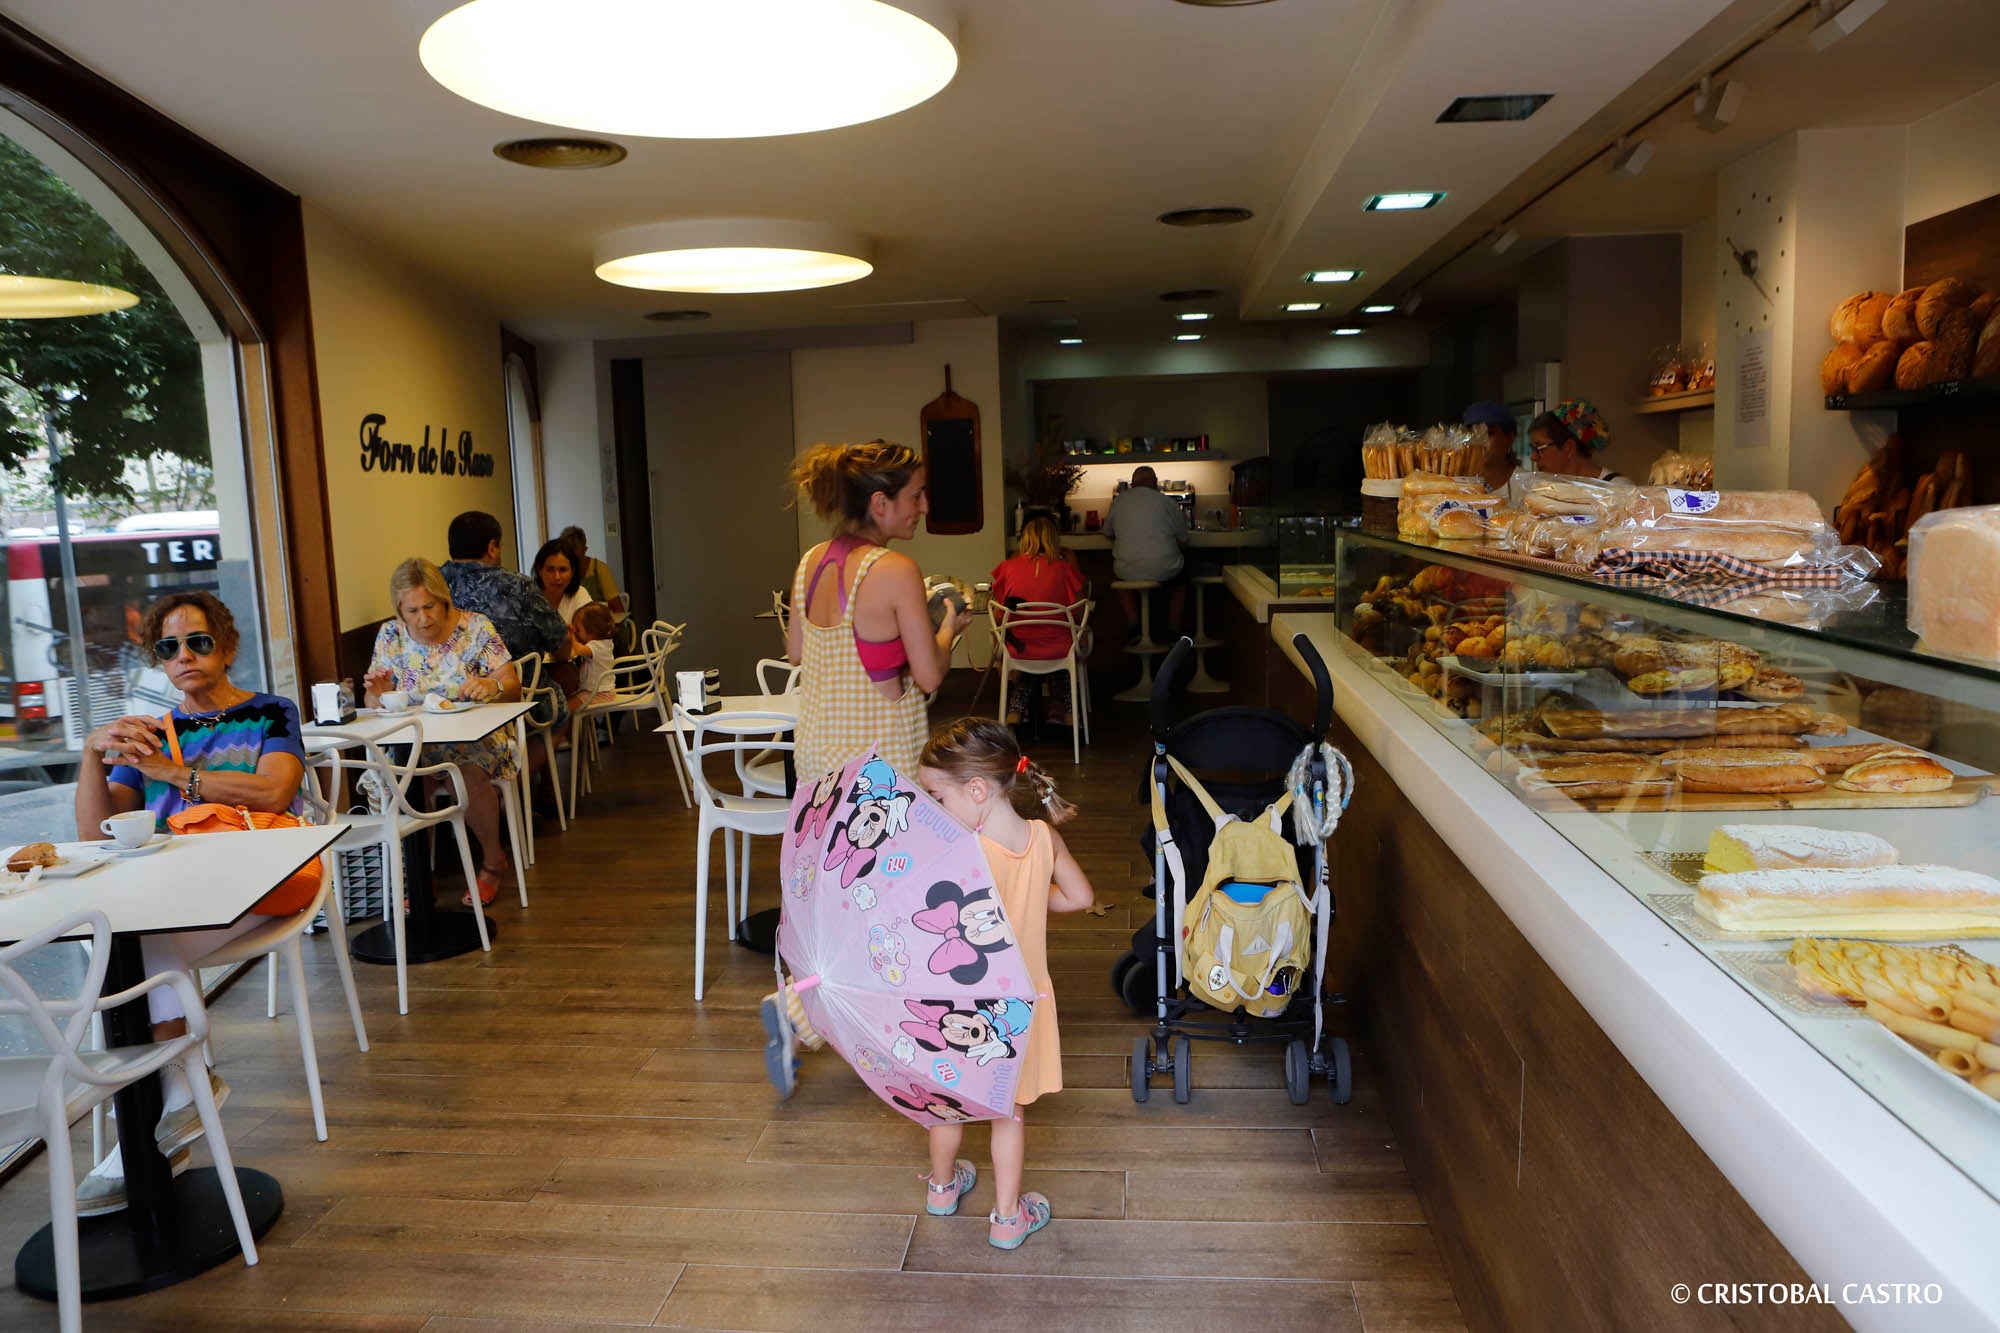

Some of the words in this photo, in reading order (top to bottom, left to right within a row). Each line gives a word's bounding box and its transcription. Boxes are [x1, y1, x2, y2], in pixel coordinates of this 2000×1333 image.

[360, 413, 416, 473] Forn
[418, 425, 438, 475] de
[440, 427, 456, 476] la
[141, 539, 216, 564] TER
